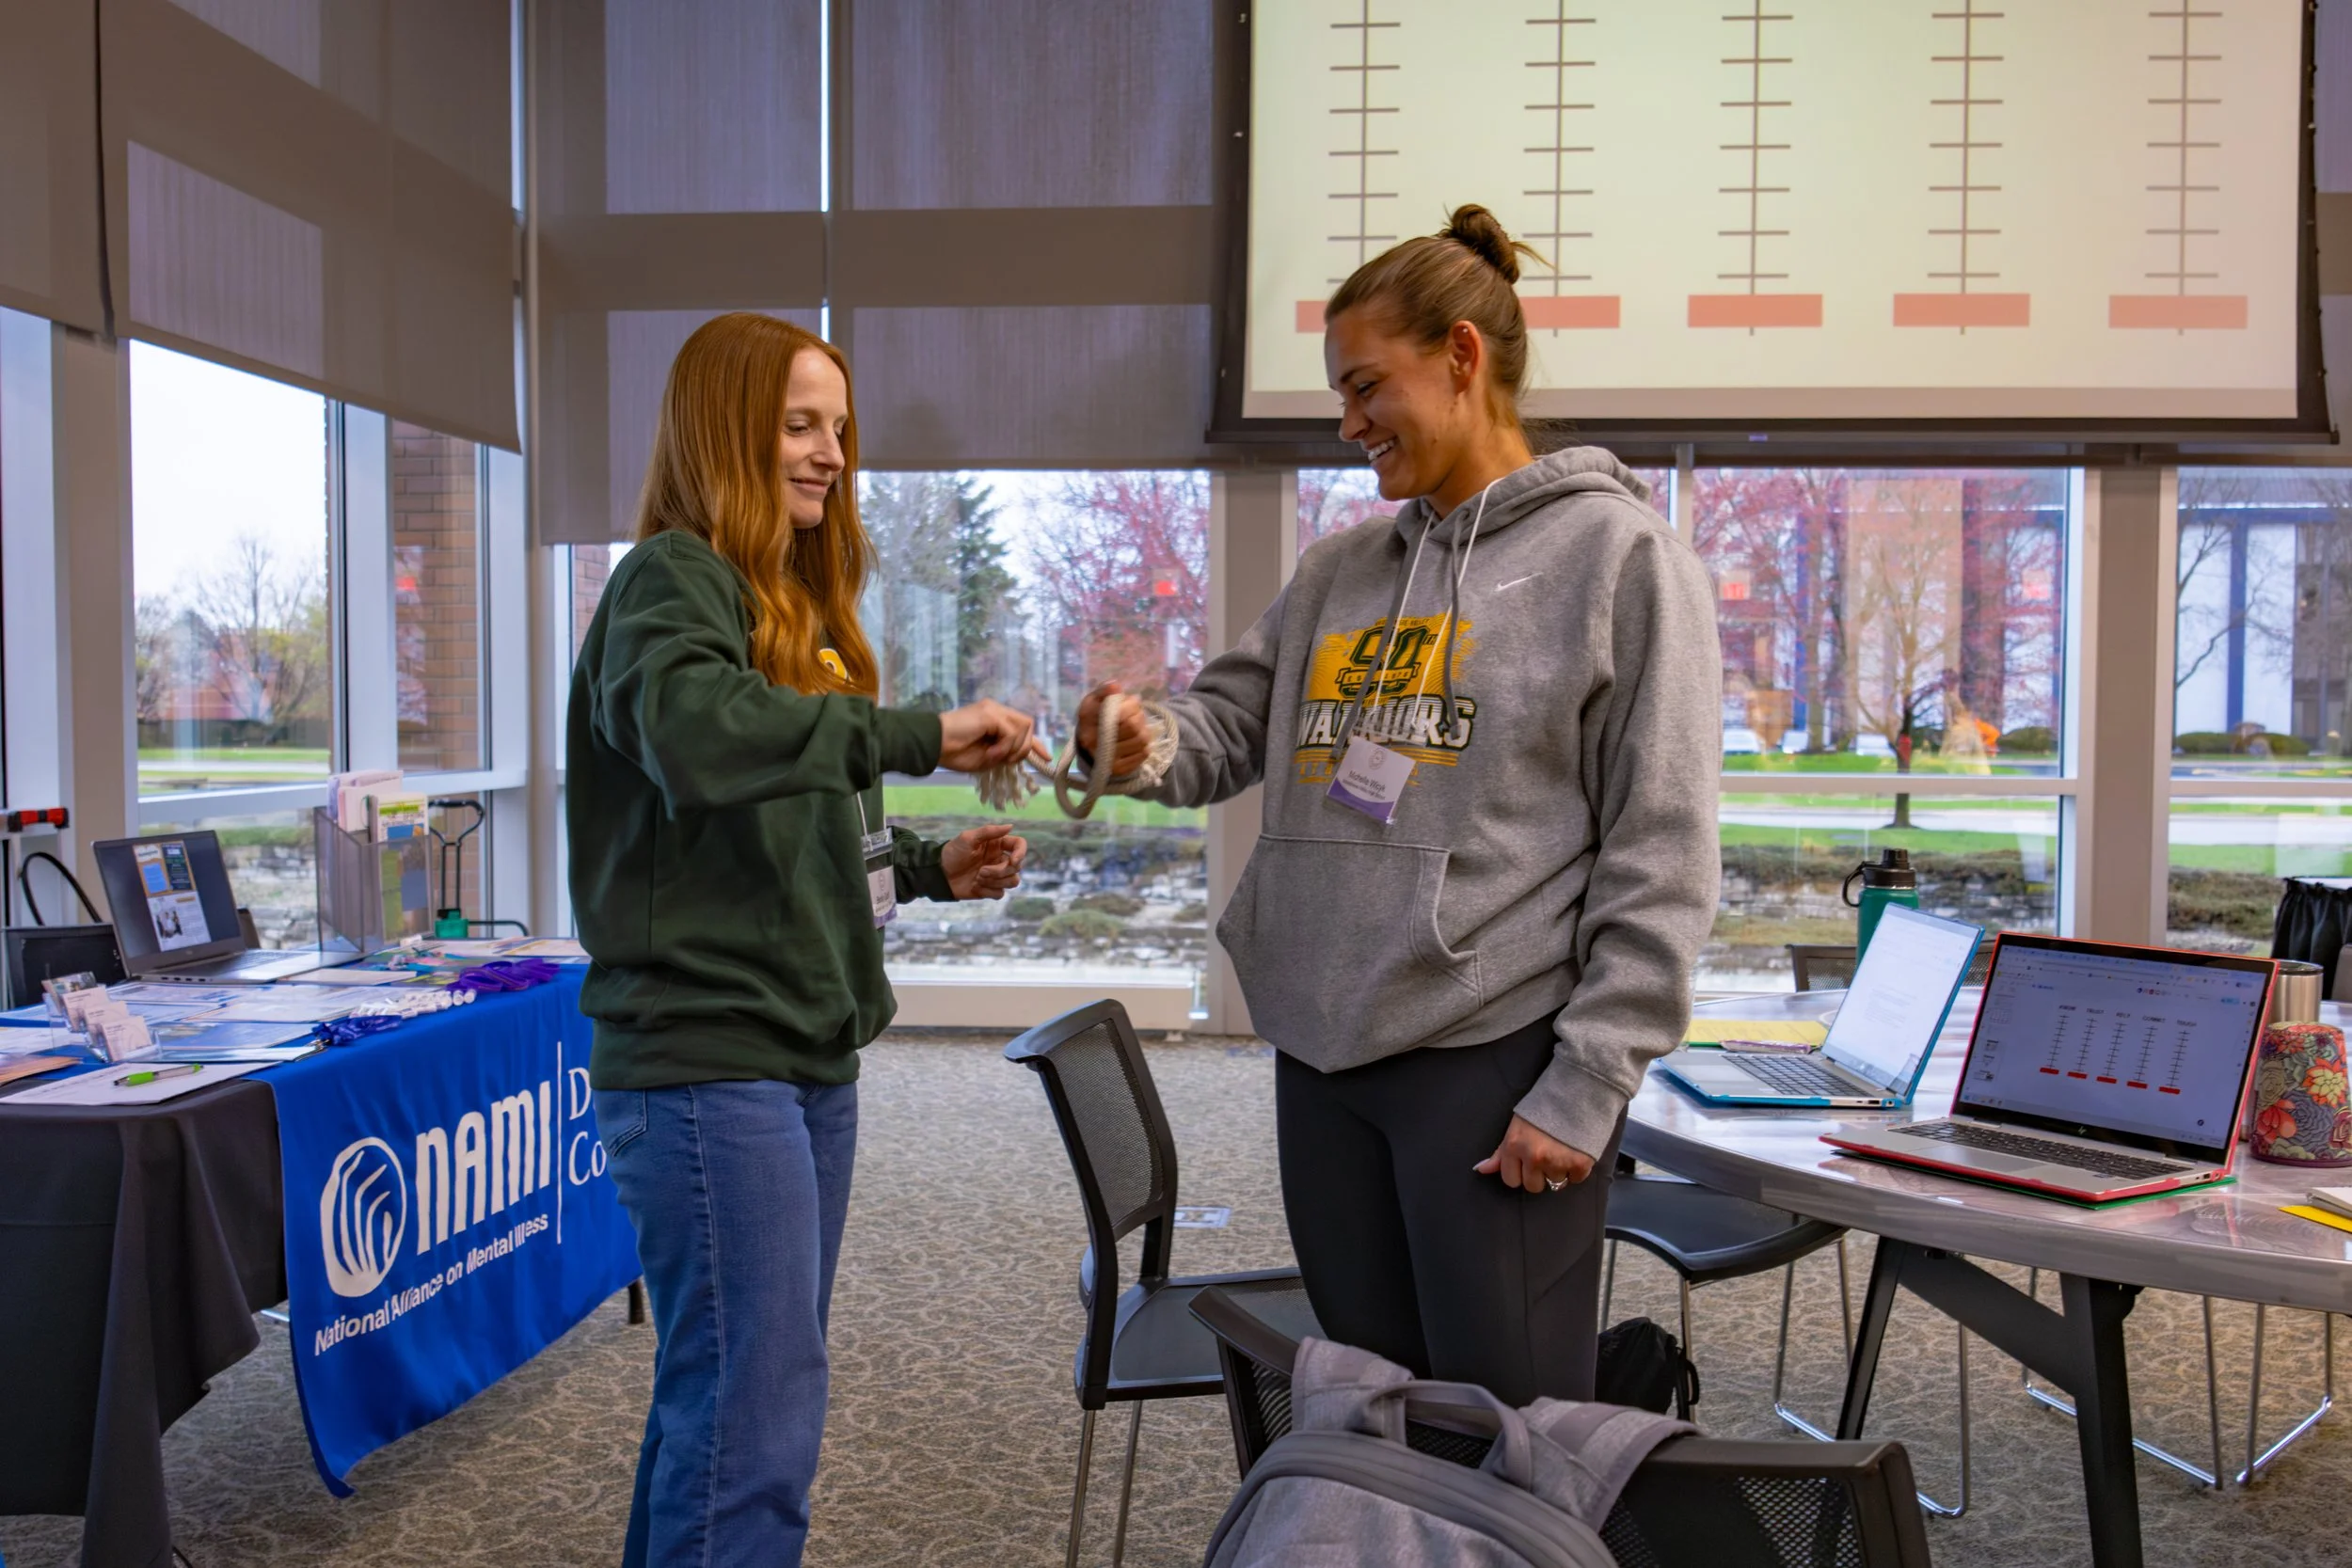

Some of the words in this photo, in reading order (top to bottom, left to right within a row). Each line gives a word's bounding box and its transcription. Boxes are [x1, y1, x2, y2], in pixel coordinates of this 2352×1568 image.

[314, 1299, 390, 1356] National
[391, 1274, 444, 1321] Alliance
[446, 1261, 464, 1286] on
[467, 1230, 514, 1275] Mental
